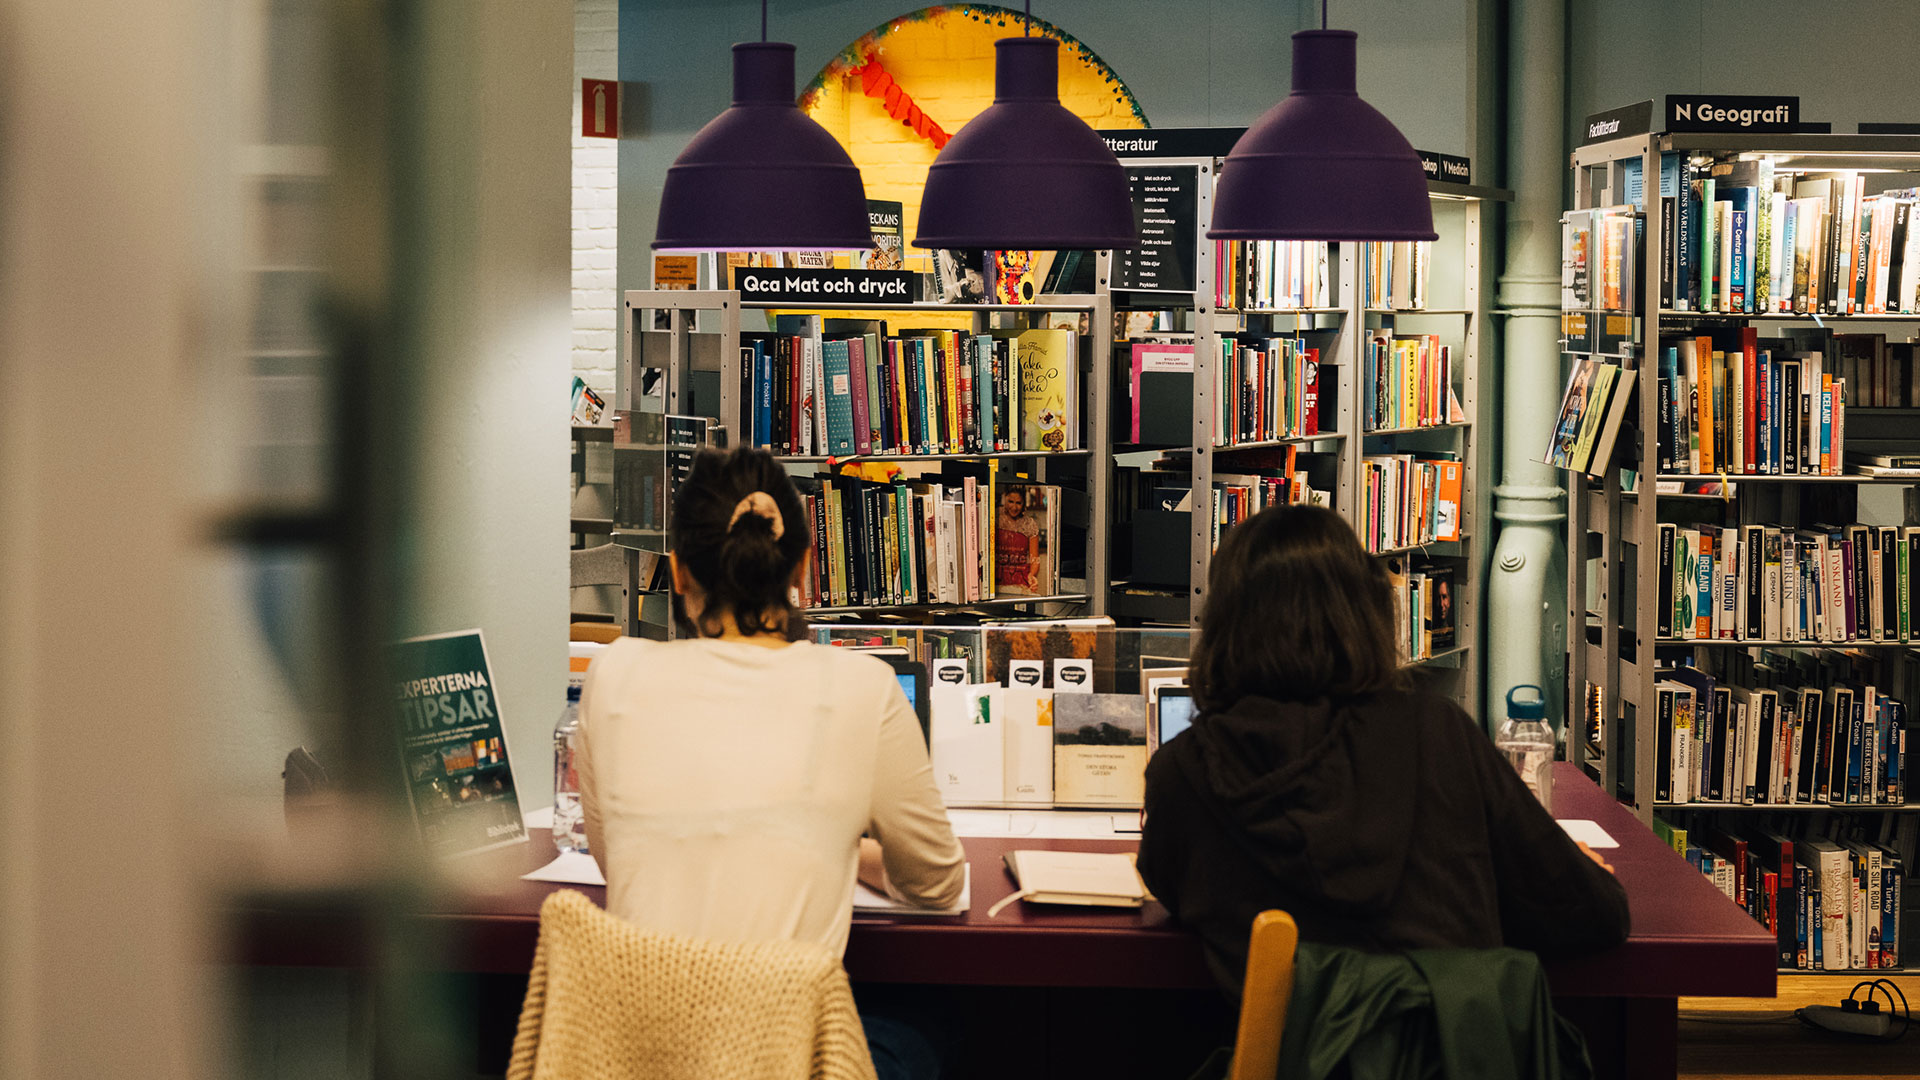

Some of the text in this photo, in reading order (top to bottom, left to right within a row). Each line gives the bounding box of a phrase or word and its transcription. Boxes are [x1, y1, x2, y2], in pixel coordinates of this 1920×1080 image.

[1675, 104, 1790, 126] N Geografi
[1443, 160, 1447, 173] V
[1448, 161, 1468, 176] Medicin
[1680, 164, 1689, 266] FAMILJENS VÄRLDSATLAS
[1897, 206, 1905, 224] Sverige
[800, 256, 823, 266] MATEN
[743, 276, 907, 298] Qca Mat och dryck
[1823, 394, 1831, 423] ICELAND
[1699, 556, 1709, 592] IRELAND
[1784, 558, 1793, 600] BERLIN
[1832, 553, 1842, 607] TYSKLAND
[1724, 575, 1734, 611] LONDON
[402, 689, 494, 731] TIPSAR
[1853, 721, 1861, 745] Croatia
[1833, 859, 1843, 913] JERUSALEM
[1871, 856, 1880, 910] THE SILK ROAD
[1885, 886, 1893, 914] Turkey
